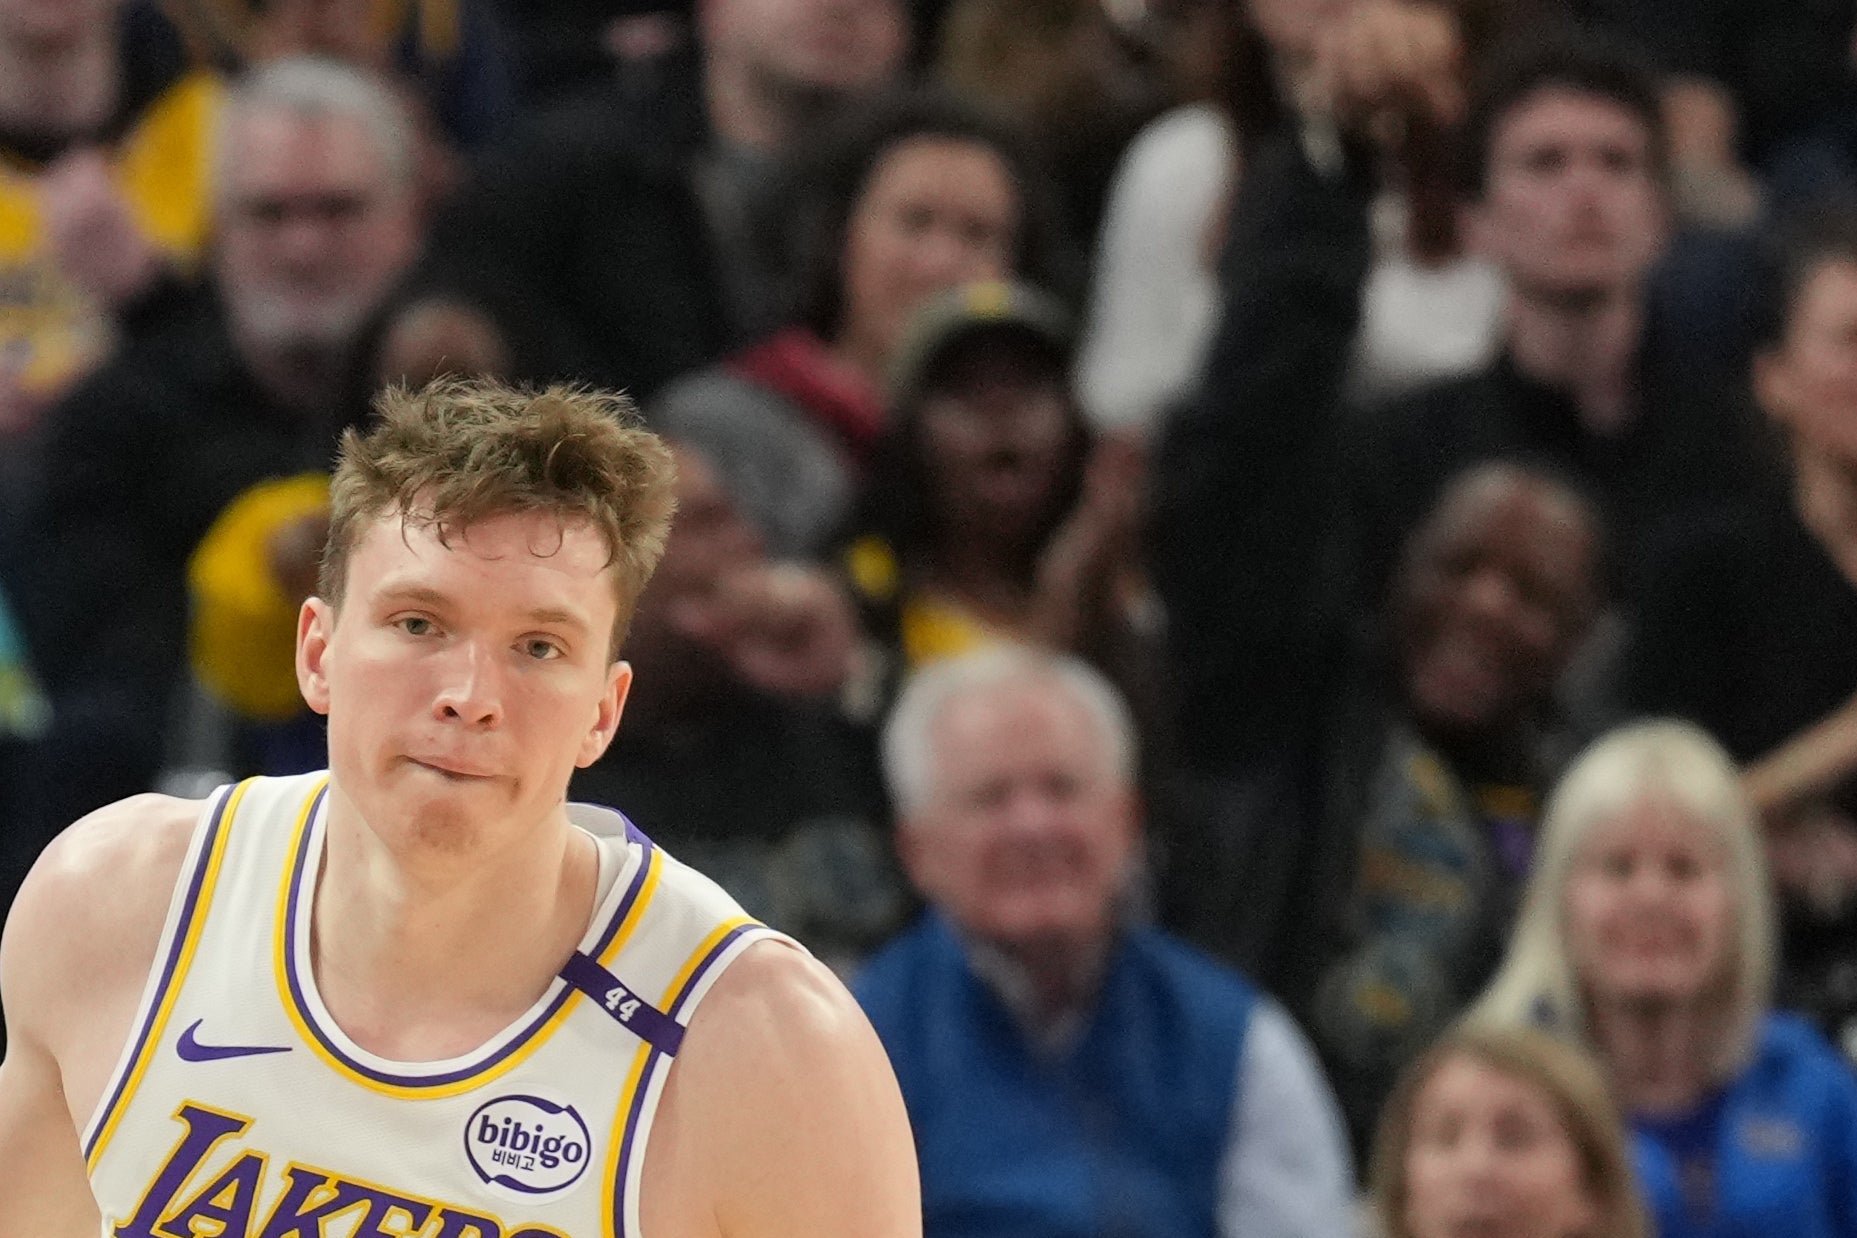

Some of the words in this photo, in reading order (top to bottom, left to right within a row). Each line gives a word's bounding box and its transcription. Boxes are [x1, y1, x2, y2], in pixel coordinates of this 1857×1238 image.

[605, 987, 642, 1022] 44
[477, 1114, 583, 1169] bibigo
[492, 1149, 535, 1172] 비비고
